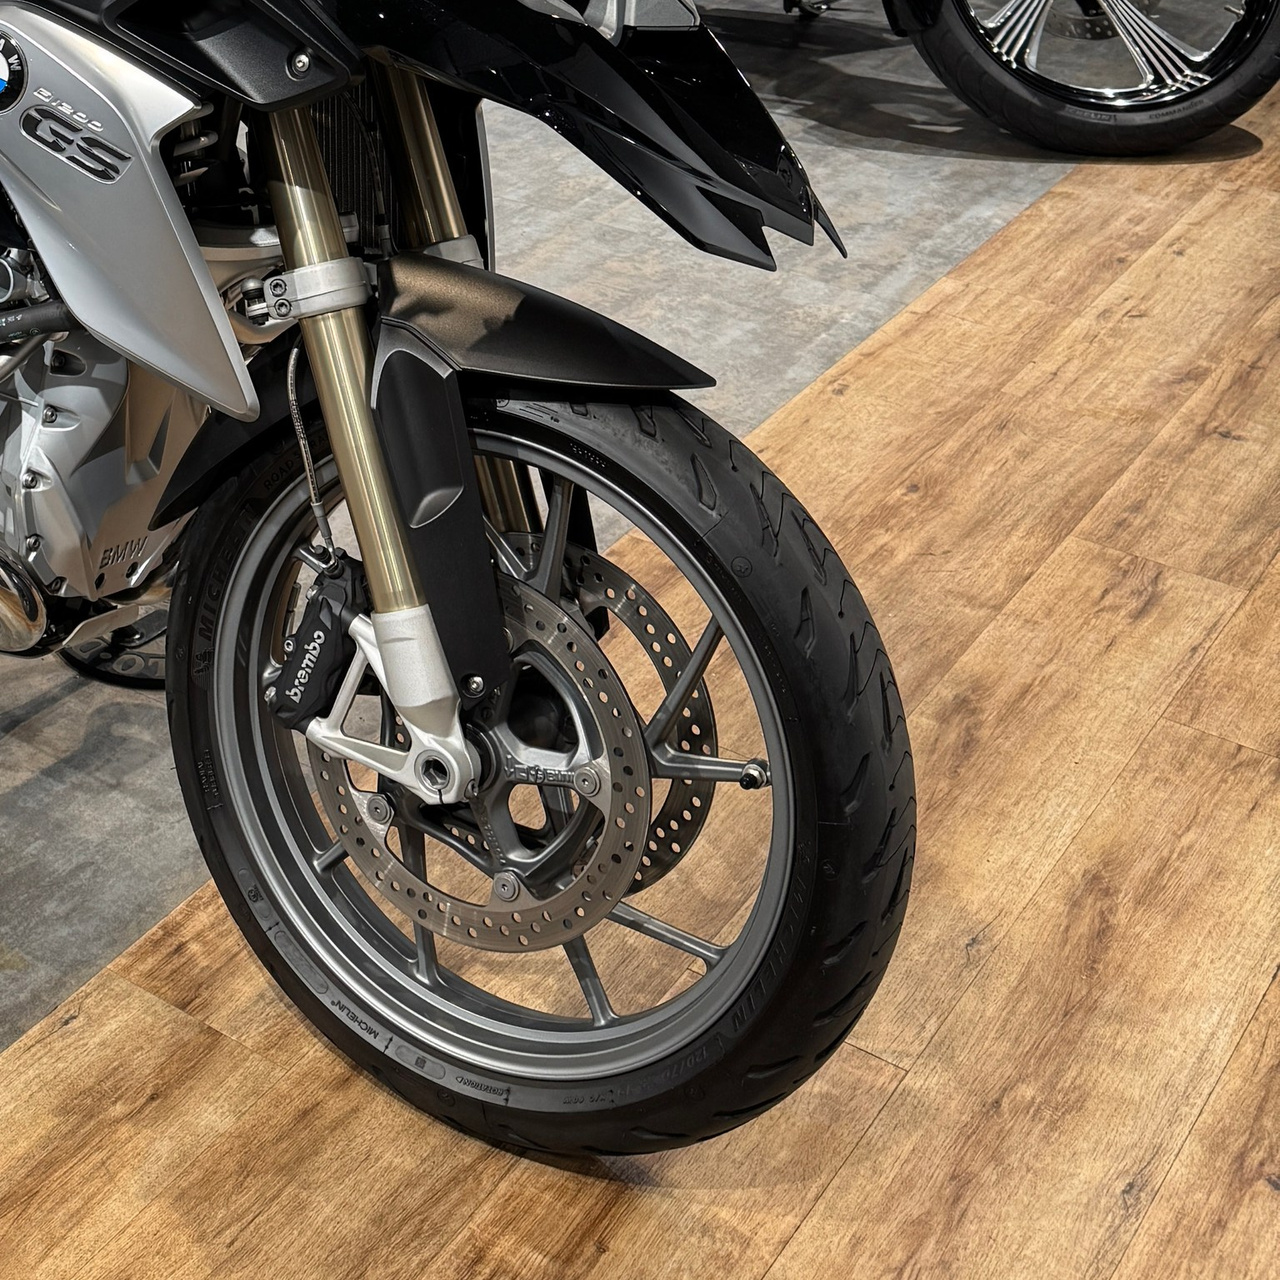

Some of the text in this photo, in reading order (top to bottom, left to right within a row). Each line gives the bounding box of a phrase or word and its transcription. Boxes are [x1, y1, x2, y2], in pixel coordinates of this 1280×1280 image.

[21, 106, 133, 181] GS
[263, 460, 294, 490] ROAD
[99, 536, 148, 570] BMW
[285, 630, 325, 704] brembo
[334, 1000, 379, 1039] MICHELIN
